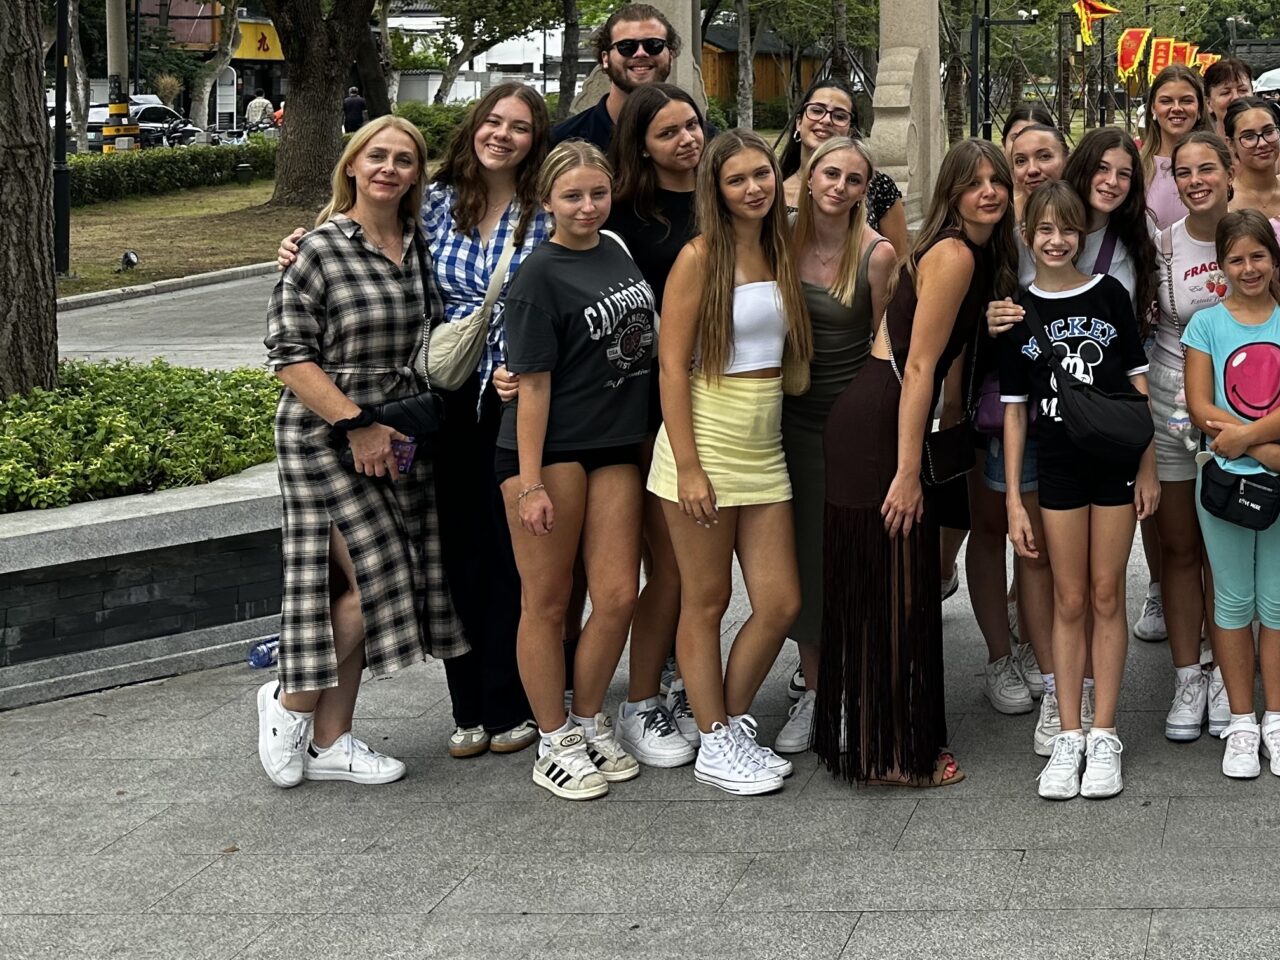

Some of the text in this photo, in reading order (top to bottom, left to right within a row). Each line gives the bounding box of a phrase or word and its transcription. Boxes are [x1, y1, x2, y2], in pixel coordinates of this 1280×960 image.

[257, 31, 270, 53] 九
[1183, 261, 1220, 281] FRAG
[584, 279, 655, 340] CALIFORN
